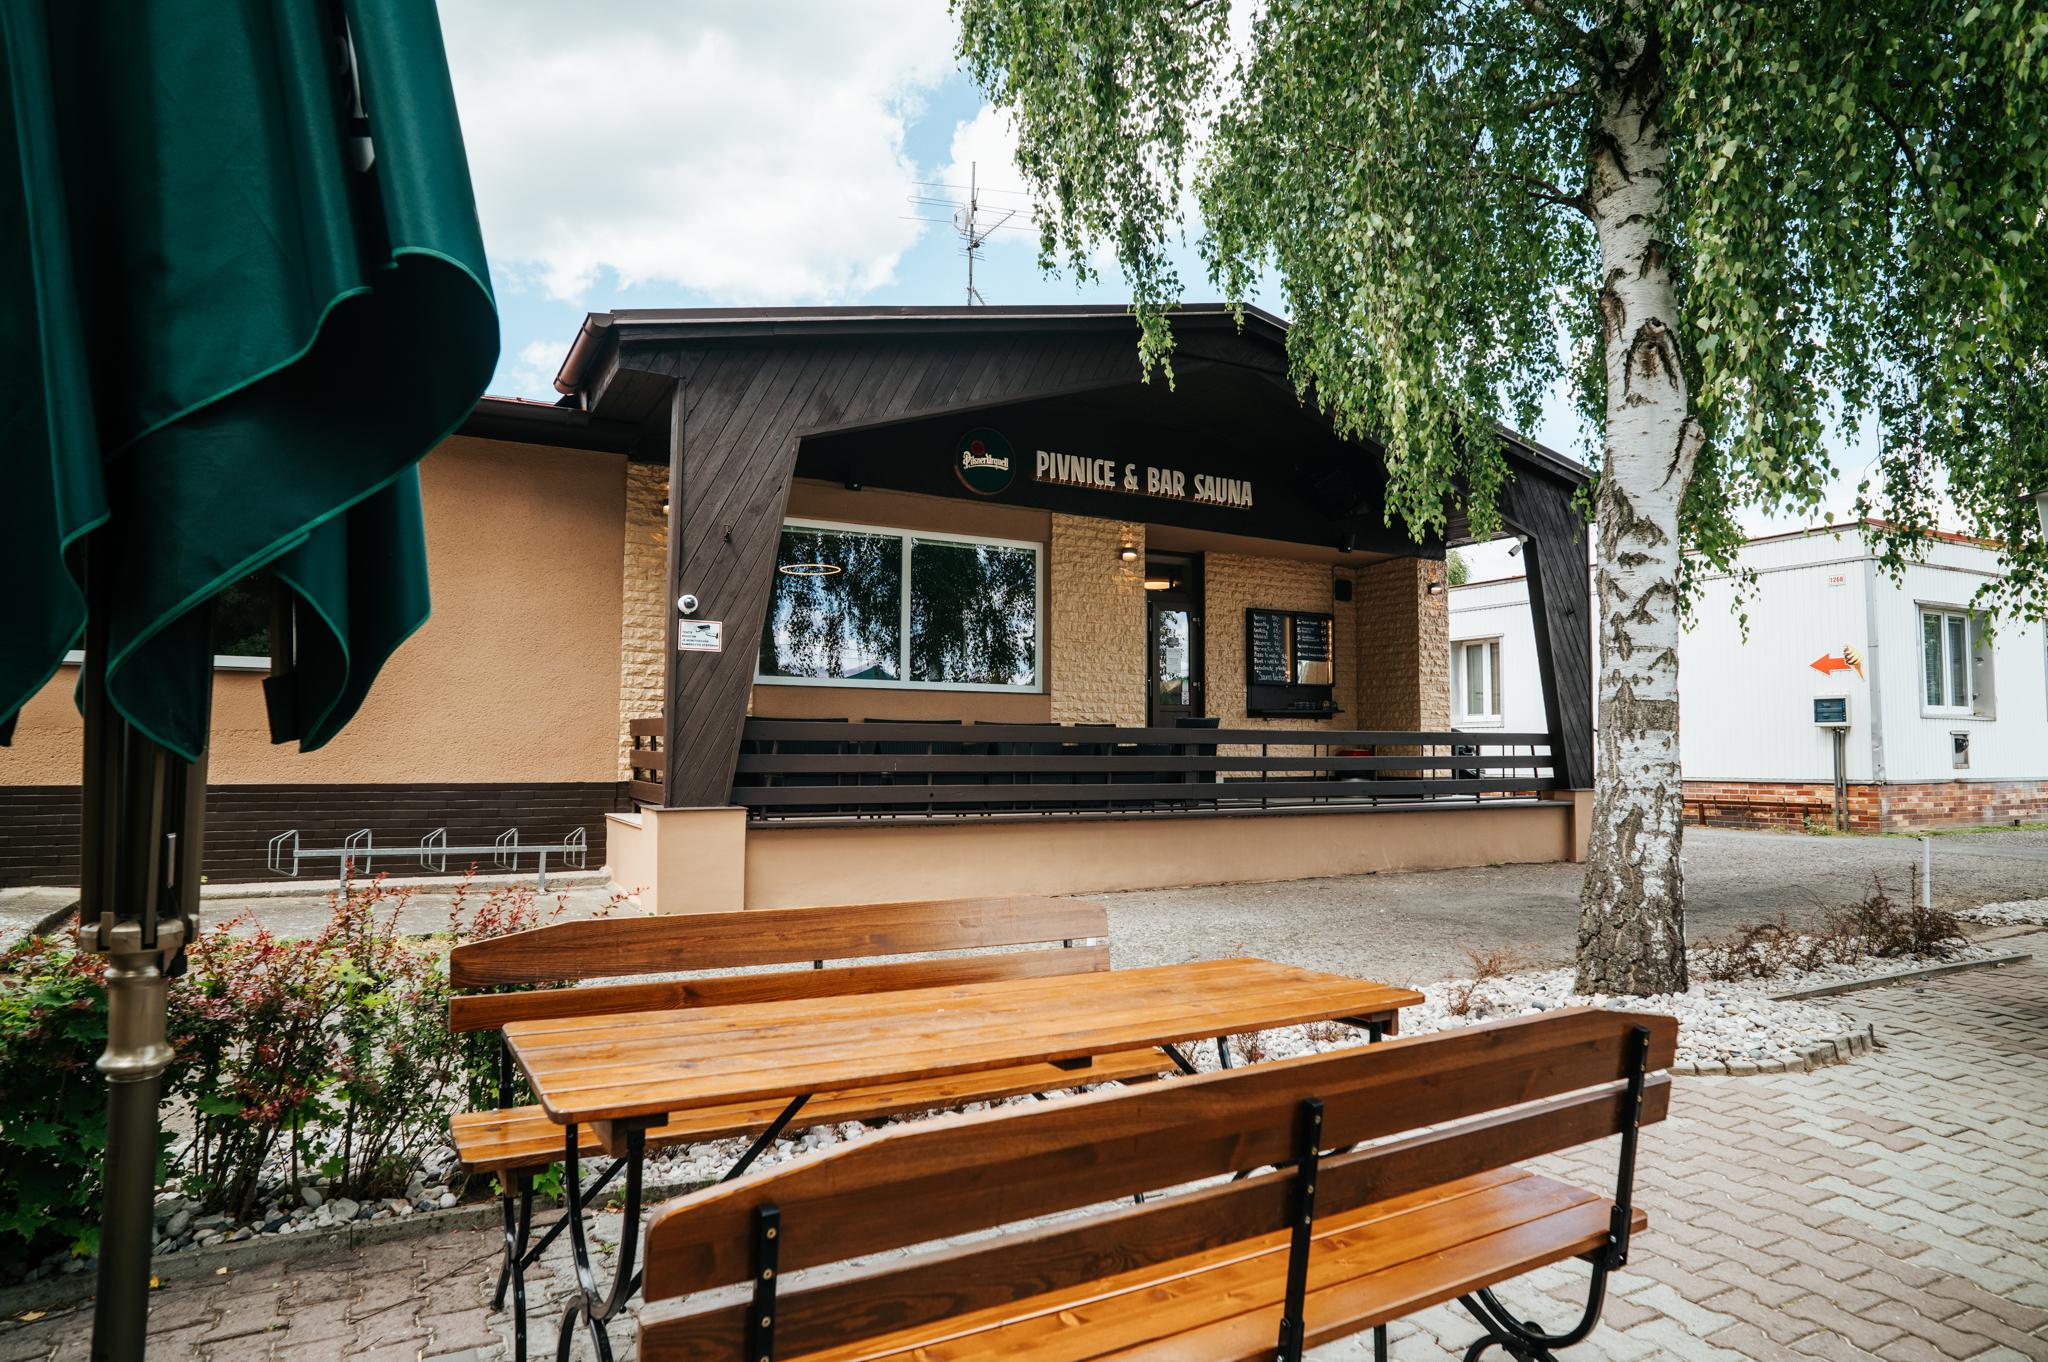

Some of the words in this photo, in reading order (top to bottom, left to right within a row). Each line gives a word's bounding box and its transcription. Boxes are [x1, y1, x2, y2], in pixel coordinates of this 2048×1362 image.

[962, 451, 987, 469] Pilsner
[985, 453, 1009, 469] Urquell
[1036, 450, 1116, 487] PIVNICE
[1124, 463, 1139, 490] &
[1147, 466, 1186, 497] BAR
[1194, 473, 1254, 506] SAUNA
